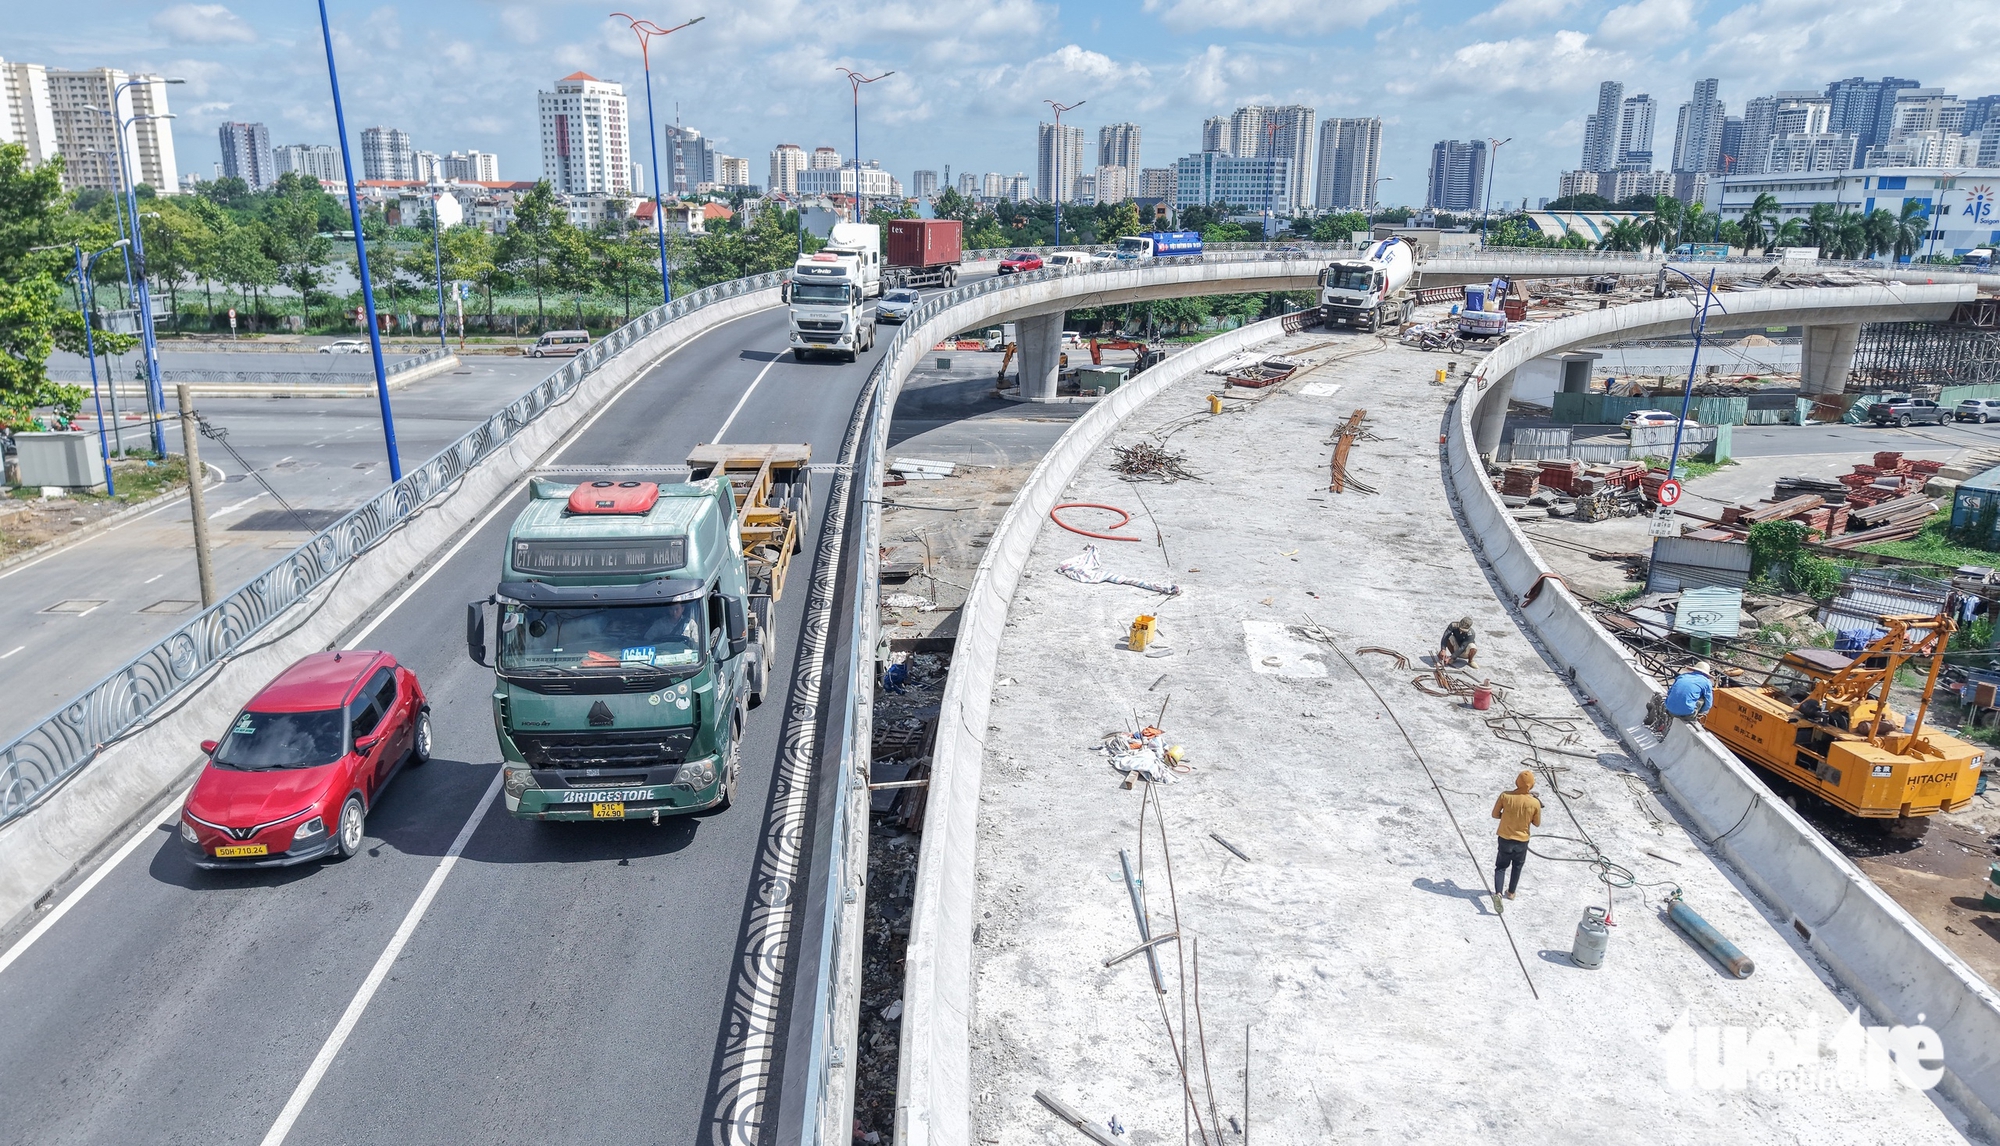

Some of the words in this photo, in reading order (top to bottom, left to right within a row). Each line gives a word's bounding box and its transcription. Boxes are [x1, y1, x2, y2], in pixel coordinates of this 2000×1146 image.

[1980, 217, 1999, 225] Saigon
[891, 226, 904, 234] tex
[1907, 772, 1957, 785] HITACHI
[563, 789, 654, 803] BRIDGESTONE
